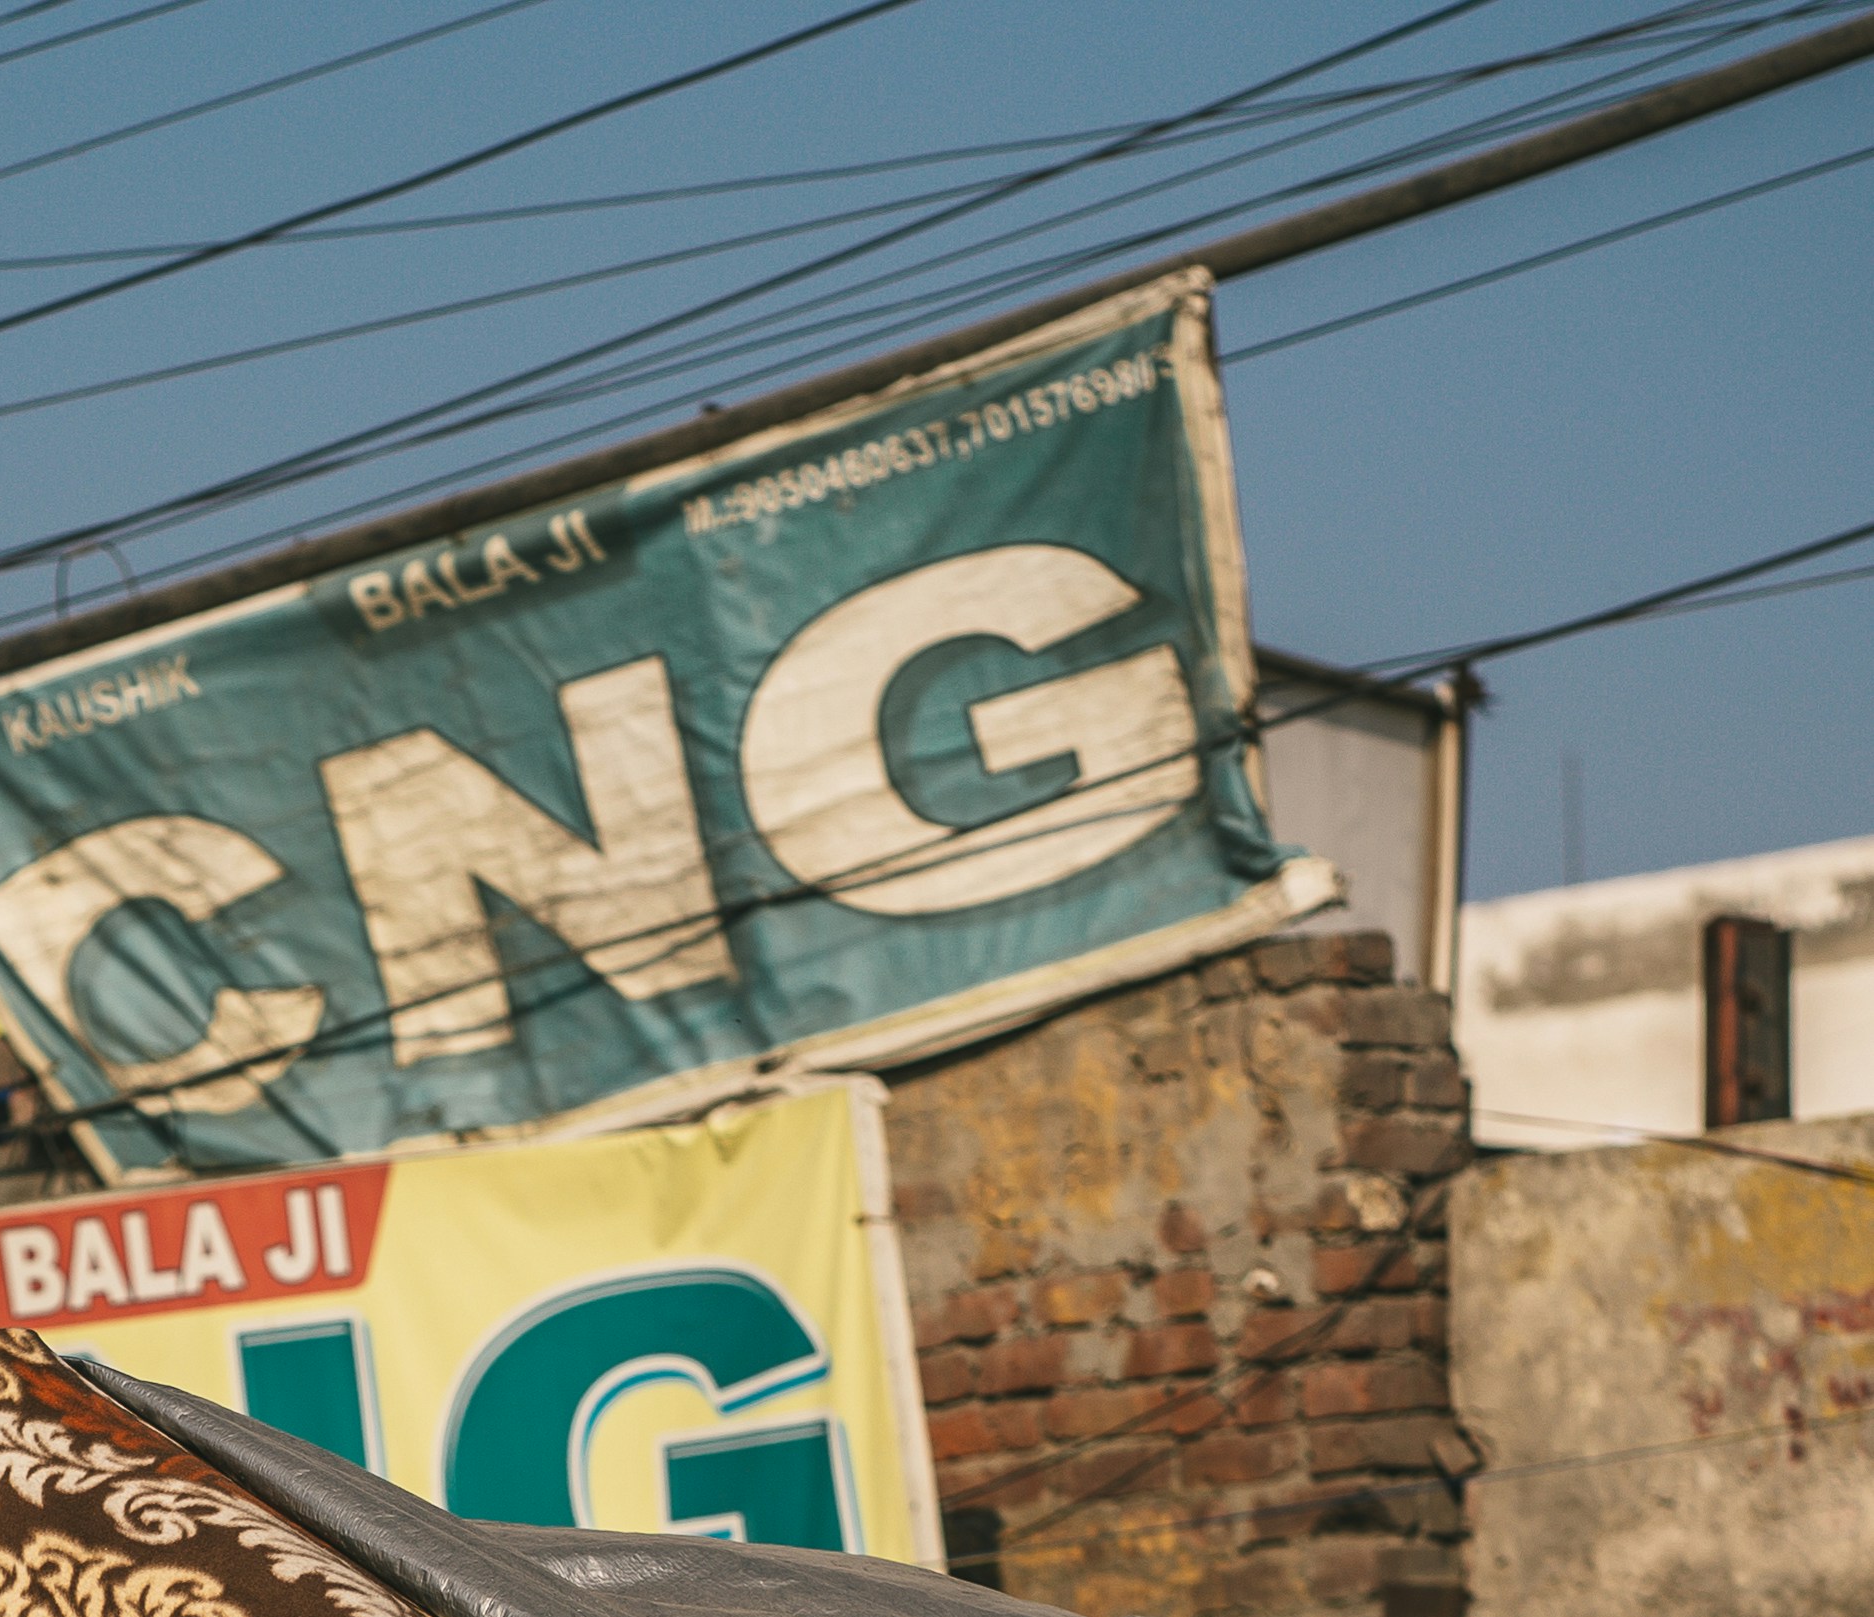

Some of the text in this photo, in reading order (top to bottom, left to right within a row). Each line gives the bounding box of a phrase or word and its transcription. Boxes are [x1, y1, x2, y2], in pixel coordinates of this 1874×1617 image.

[348, 509, 607, 632] BALA JI
[3, 654, 201, 754] KAUSHIK
[0, 1184, 354, 1316] BALA JI
